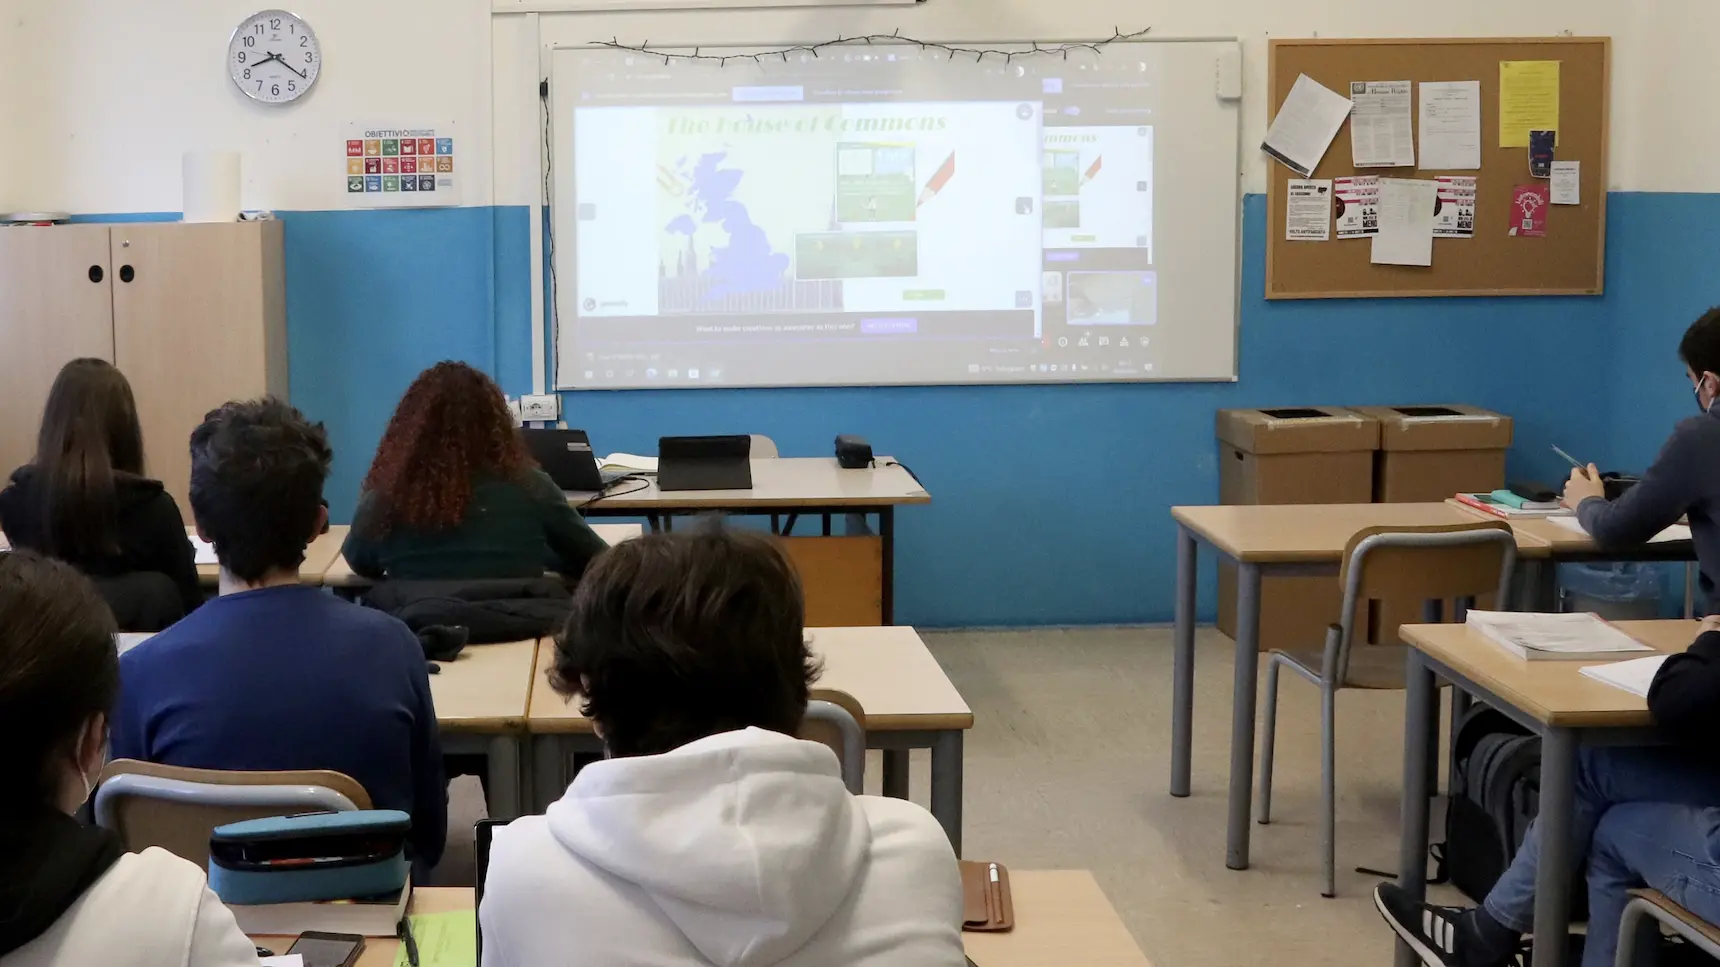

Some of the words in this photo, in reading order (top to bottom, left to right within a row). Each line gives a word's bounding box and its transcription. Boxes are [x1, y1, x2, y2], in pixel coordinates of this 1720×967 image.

[254, 24, 264, 35] 11
[270, 18, 281, 31] 12
[242, 36, 255, 48] 10
[300, 36, 308, 47] 2
[238, 52, 246, 63] 9
[305, 52, 313, 63] 3
[243, 68, 251, 80] 8
[256, 80, 263, 91] 7
[271, 84, 280, 96] 6
[288, 80, 296, 92] 5
